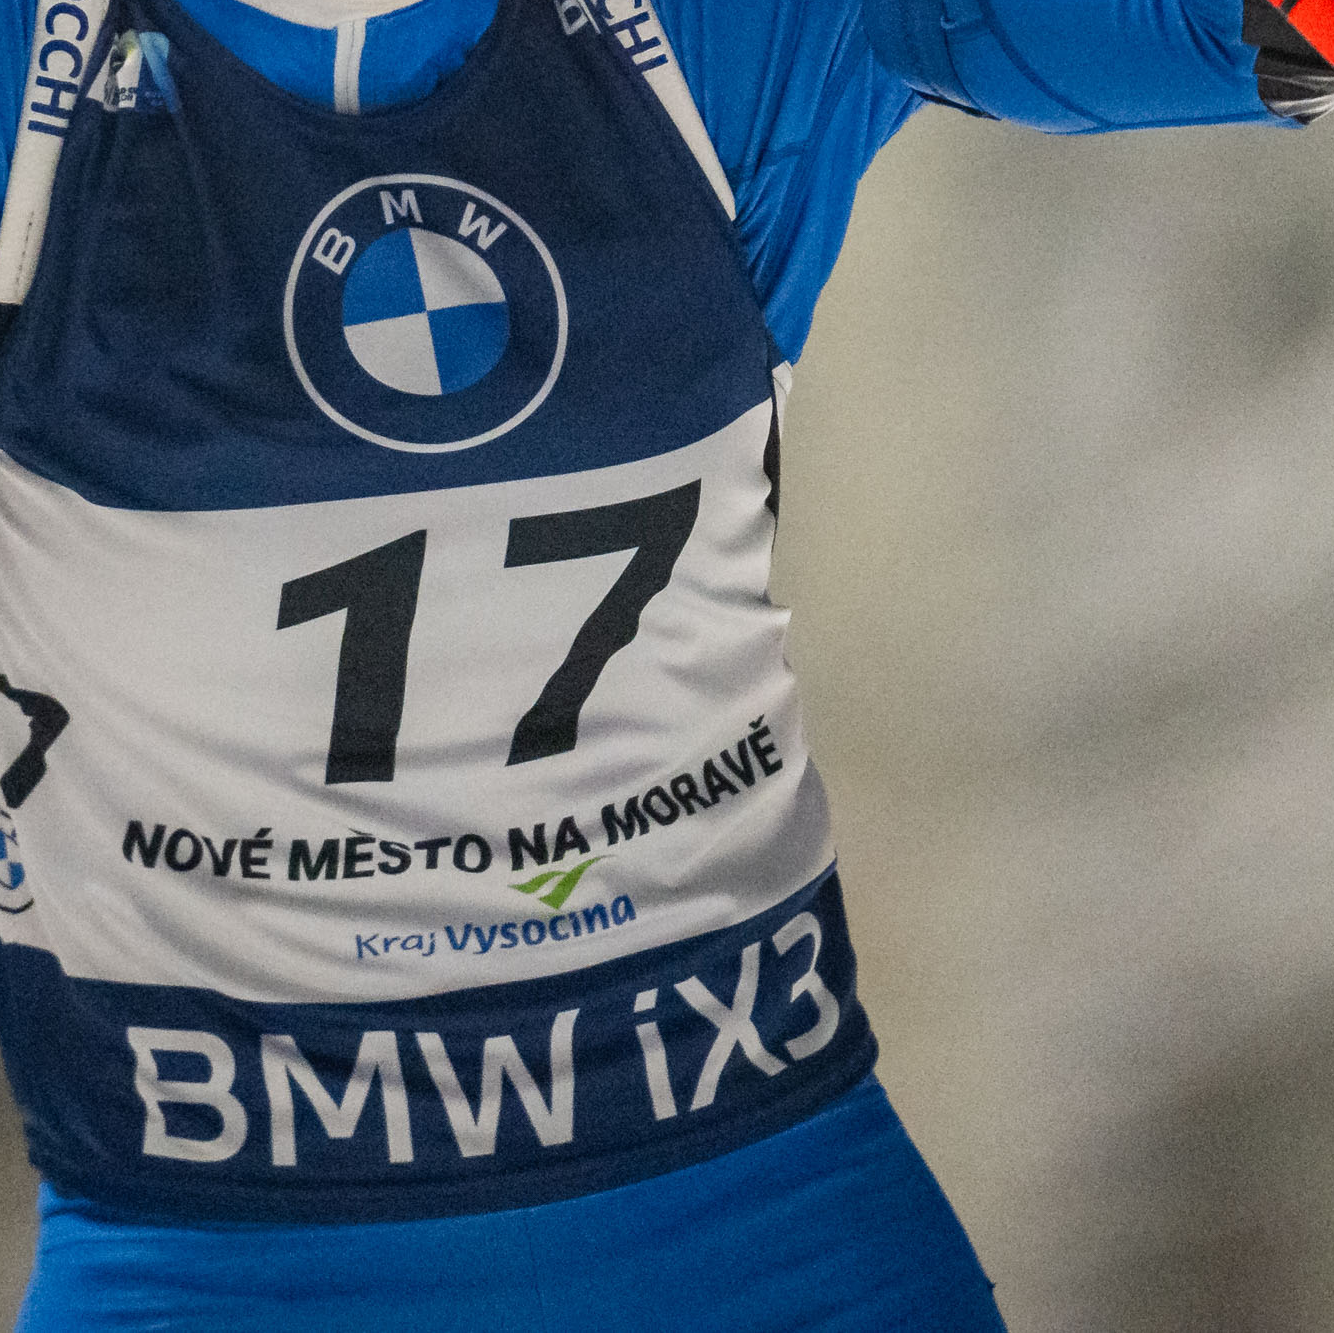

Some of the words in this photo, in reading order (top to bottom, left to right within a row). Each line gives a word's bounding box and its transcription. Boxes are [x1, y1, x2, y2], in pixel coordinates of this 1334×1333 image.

[312, 189, 508, 275] BMW
[275, 478, 701, 784] 17
[122, 819, 274, 879] NOVÉ
[288, 828, 493, 881] MĚSTO
[509, 819, 589, 872] NA
[604, 714, 784, 848] MORAVĚ
[354, 928, 435, 959] Kraj
[128, 1008, 579, 1168] BMW
[633, 912, 844, 1122] iX3
